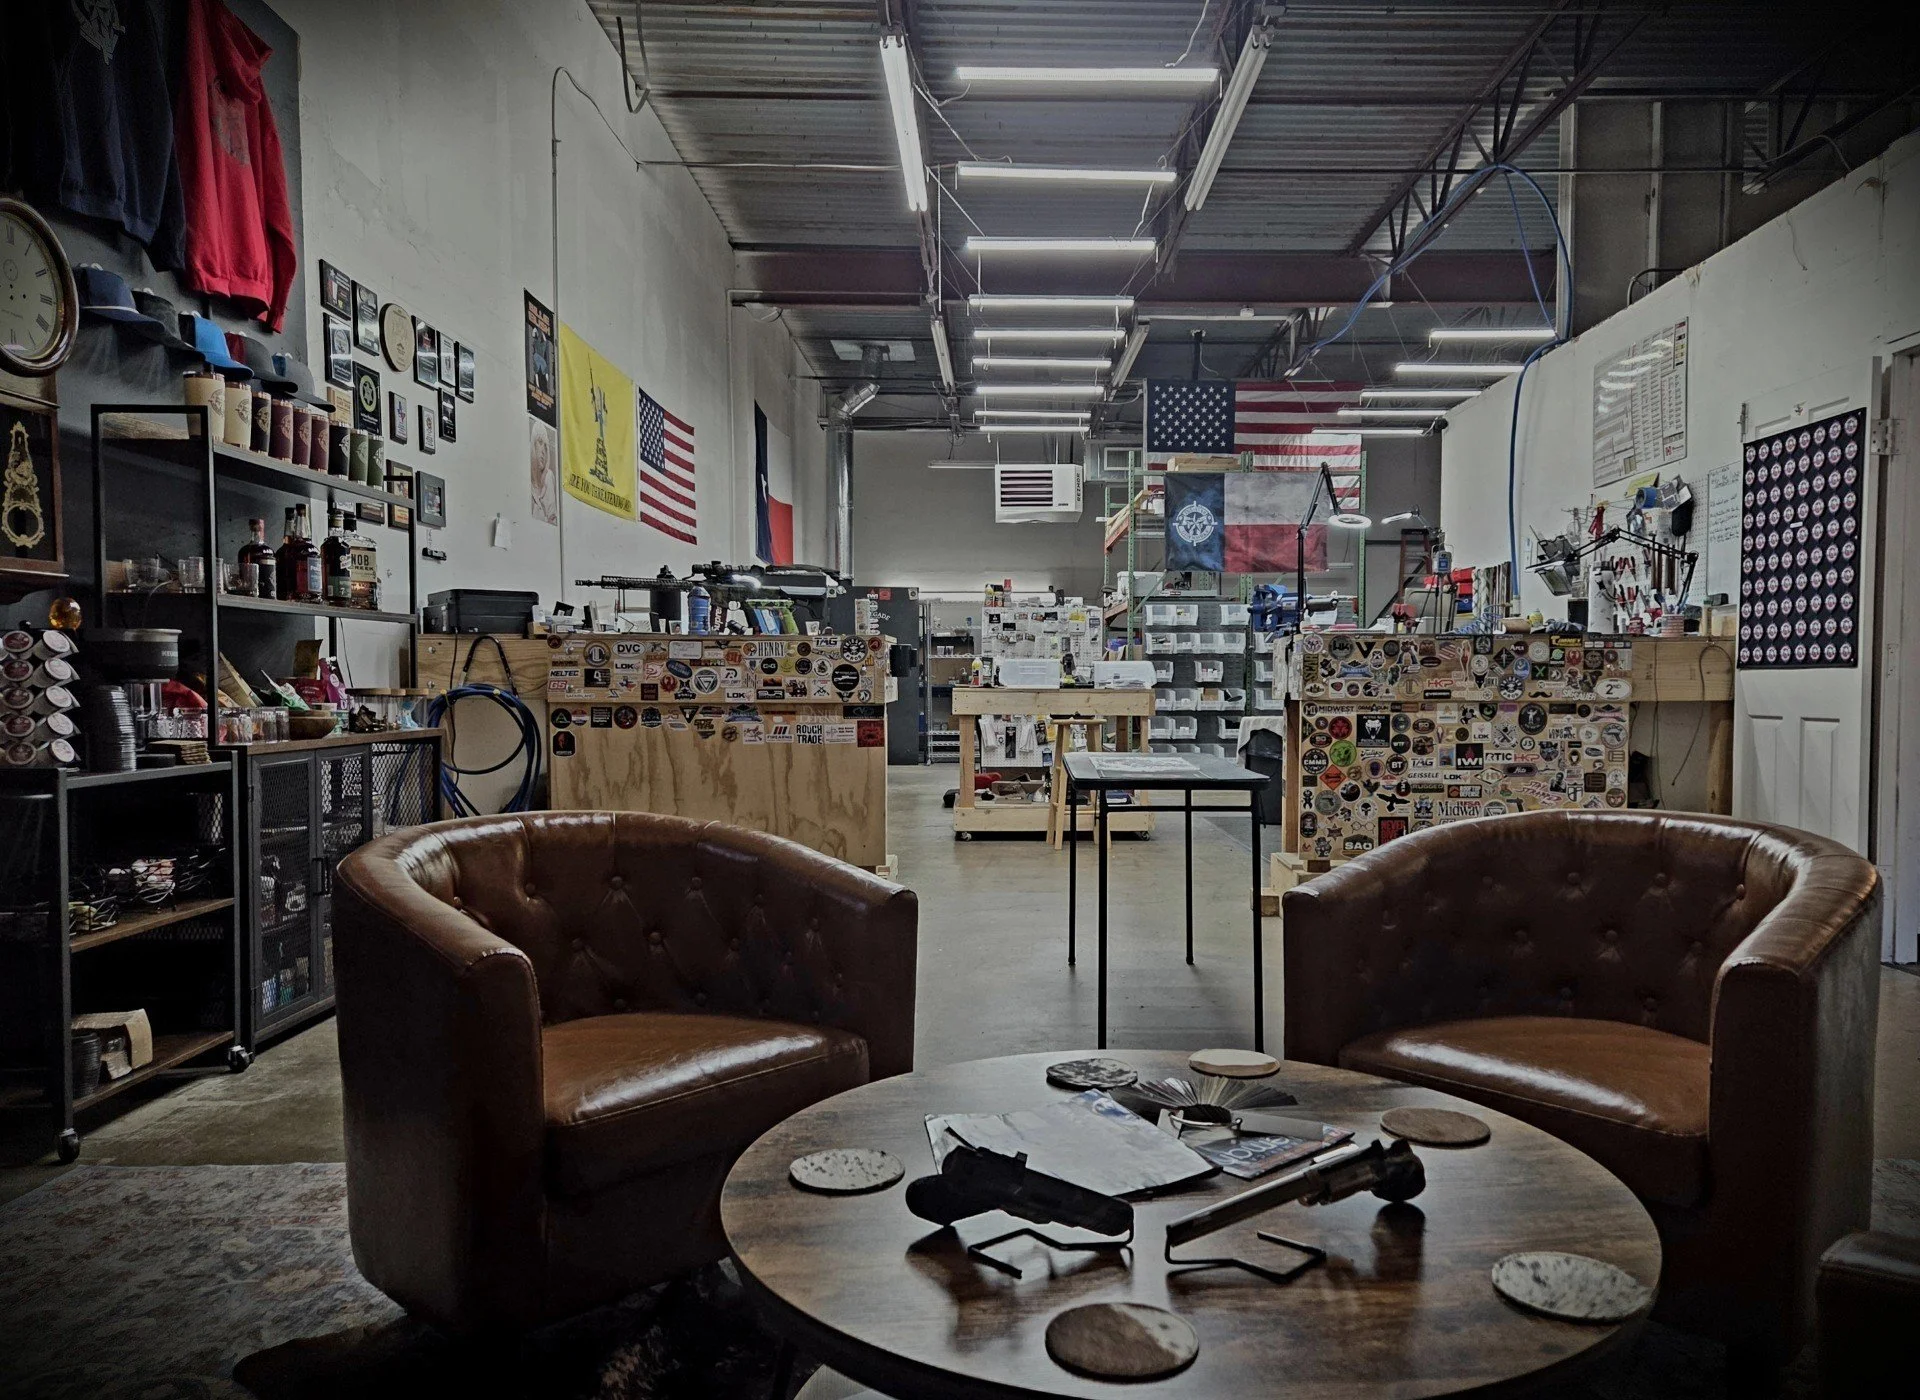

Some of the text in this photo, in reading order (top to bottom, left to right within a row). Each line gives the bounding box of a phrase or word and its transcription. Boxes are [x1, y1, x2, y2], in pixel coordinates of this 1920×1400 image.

[351, 554, 369, 566] NOB
[814, 638, 837, 646] TAG
[617, 644, 640, 653] DVC
[758, 641, 785, 656] HENRY
[796, 724, 823, 734] ROUGH
[797, 735, 823, 744] TRADE
[1457, 757, 1483, 766] IWI
[1485, 753, 1512, 761] RTIC
[1411, 758, 1434, 766] TAG
[1438, 801, 1481, 817] Midway
